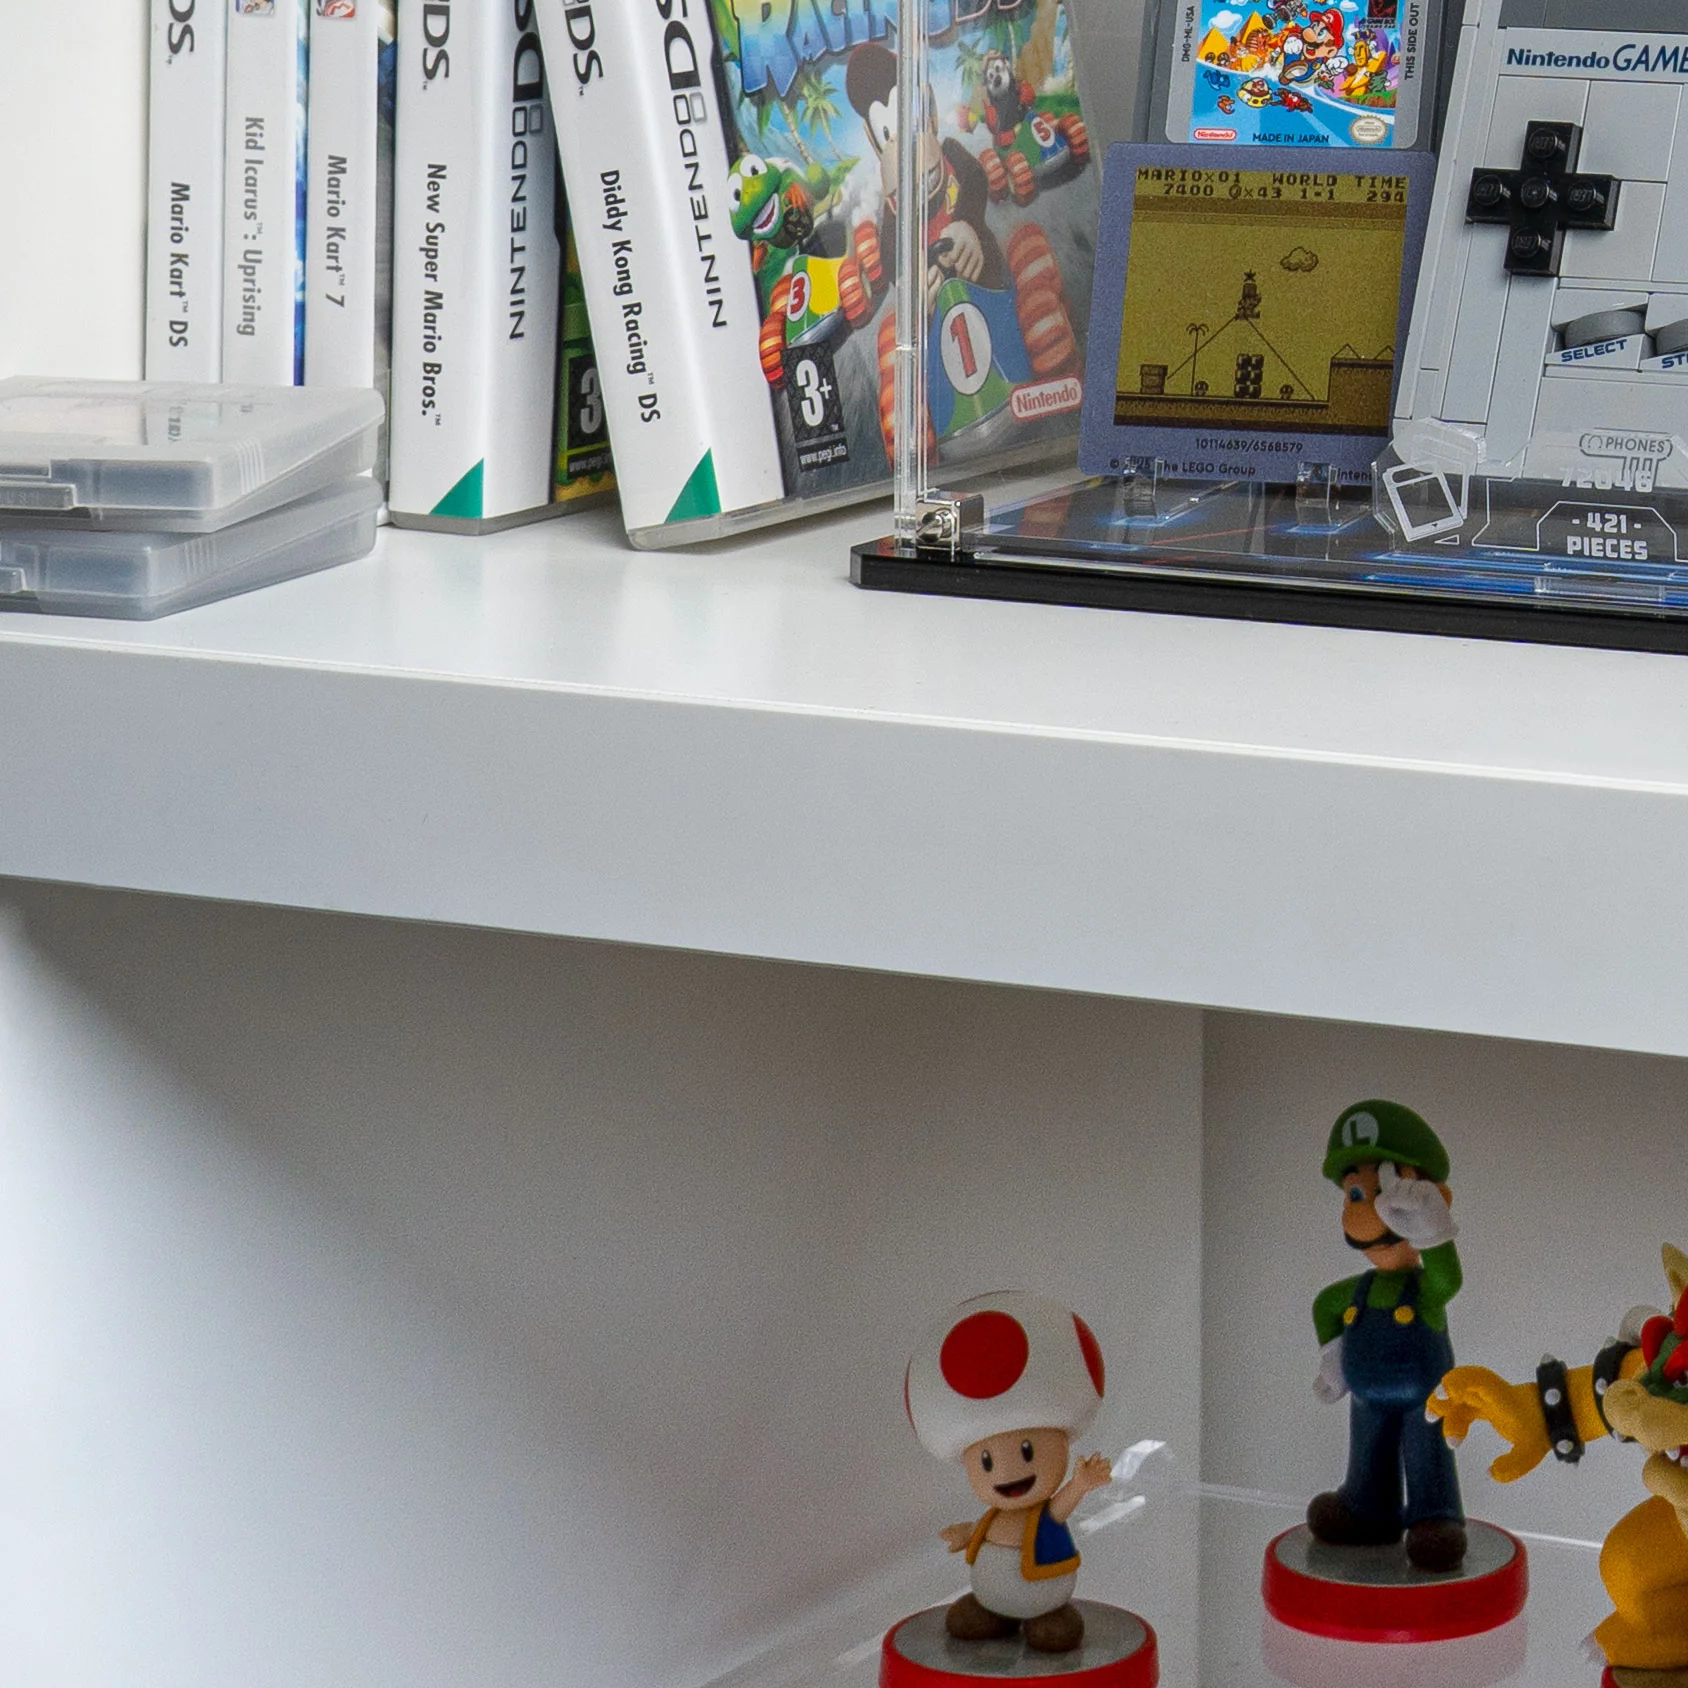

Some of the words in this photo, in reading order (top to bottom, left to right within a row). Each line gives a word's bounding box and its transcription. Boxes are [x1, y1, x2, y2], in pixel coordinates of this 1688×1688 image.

[1409, 2, 1420, 27] OUT
[1406, 28, 1418, 53] SIDE
[1404, 55, 1415, 81] THIS
[1506, 47, 1610, 70] Nintendo
[245, 116, 265, 151] Kid
[1253, 132, 1281, 142] MADE
[1284, 133, 1294, 143] IN
[1297, 133, 1330, 144] JAPAN
[327, 155, 348, 218] Mario
[426, 163, 447, 214] New
[1163, 183, 1215, 197] 7400
[1300, 188, 1337, 202] 1-1
[1366, 190, 1406, 204] 294
[1272, 172, 1338, 188] WORLD
[1355, 174, 1408, 190] TIME
[170, 181, 190, 244] Mario
[600, 169, 629, 233] Diddy
[673, 93, 728, 329] NINTENDO
[509, 106, 528, 339] NINTENDO
[419, 221, 446, 283] Super
[612, 239, 634, 297] Kong
[237, 250, 262, 337] Uprising
[325, 293, 346, 308] 7
[788, 280, 807, 315] 3
[169, 319, 188, 348] DS
[423, 290, 445, 354] Mario
[950, 311, 978, 379] 1
[1561, 338, 1628, 363] SELECT
[637, 392, 661, 424] DS
[1014, 385, 1079, 414] Nintendo
[1605, 437, 1666, 453] PHONES
[1181, 460, 1216, 475] LEGO
[1219, 463, 1256, 478] Group
[1566, 535, 1648, 560] PIECES
